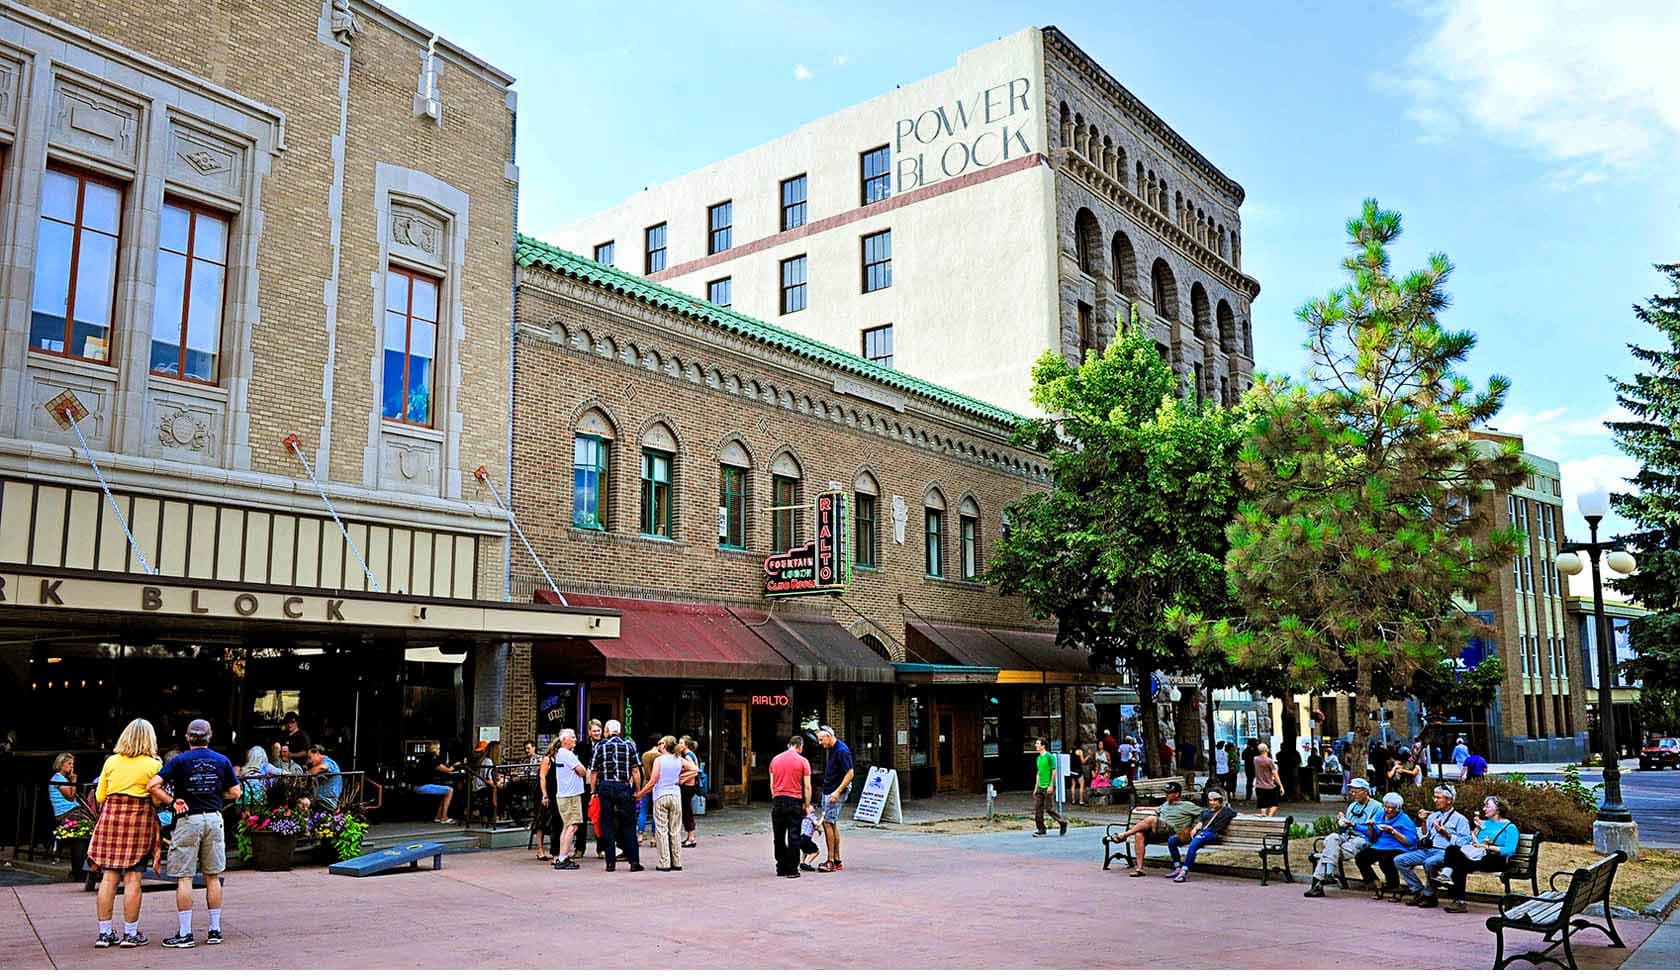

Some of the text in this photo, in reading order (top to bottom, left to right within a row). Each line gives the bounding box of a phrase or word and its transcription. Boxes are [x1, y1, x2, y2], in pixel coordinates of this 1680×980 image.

[896, 77, 1030, 153] POWER
[897, 118, 1031, 192] BLOCK
[819, 497, 832, 580] RIALTO
[769, 557, 813, 569] FOUNTAIN
[142, 586, 345, 621] BLOCK
[298, 662, 310, 671] 46
[751, 695, 789, 706] RIALTO
